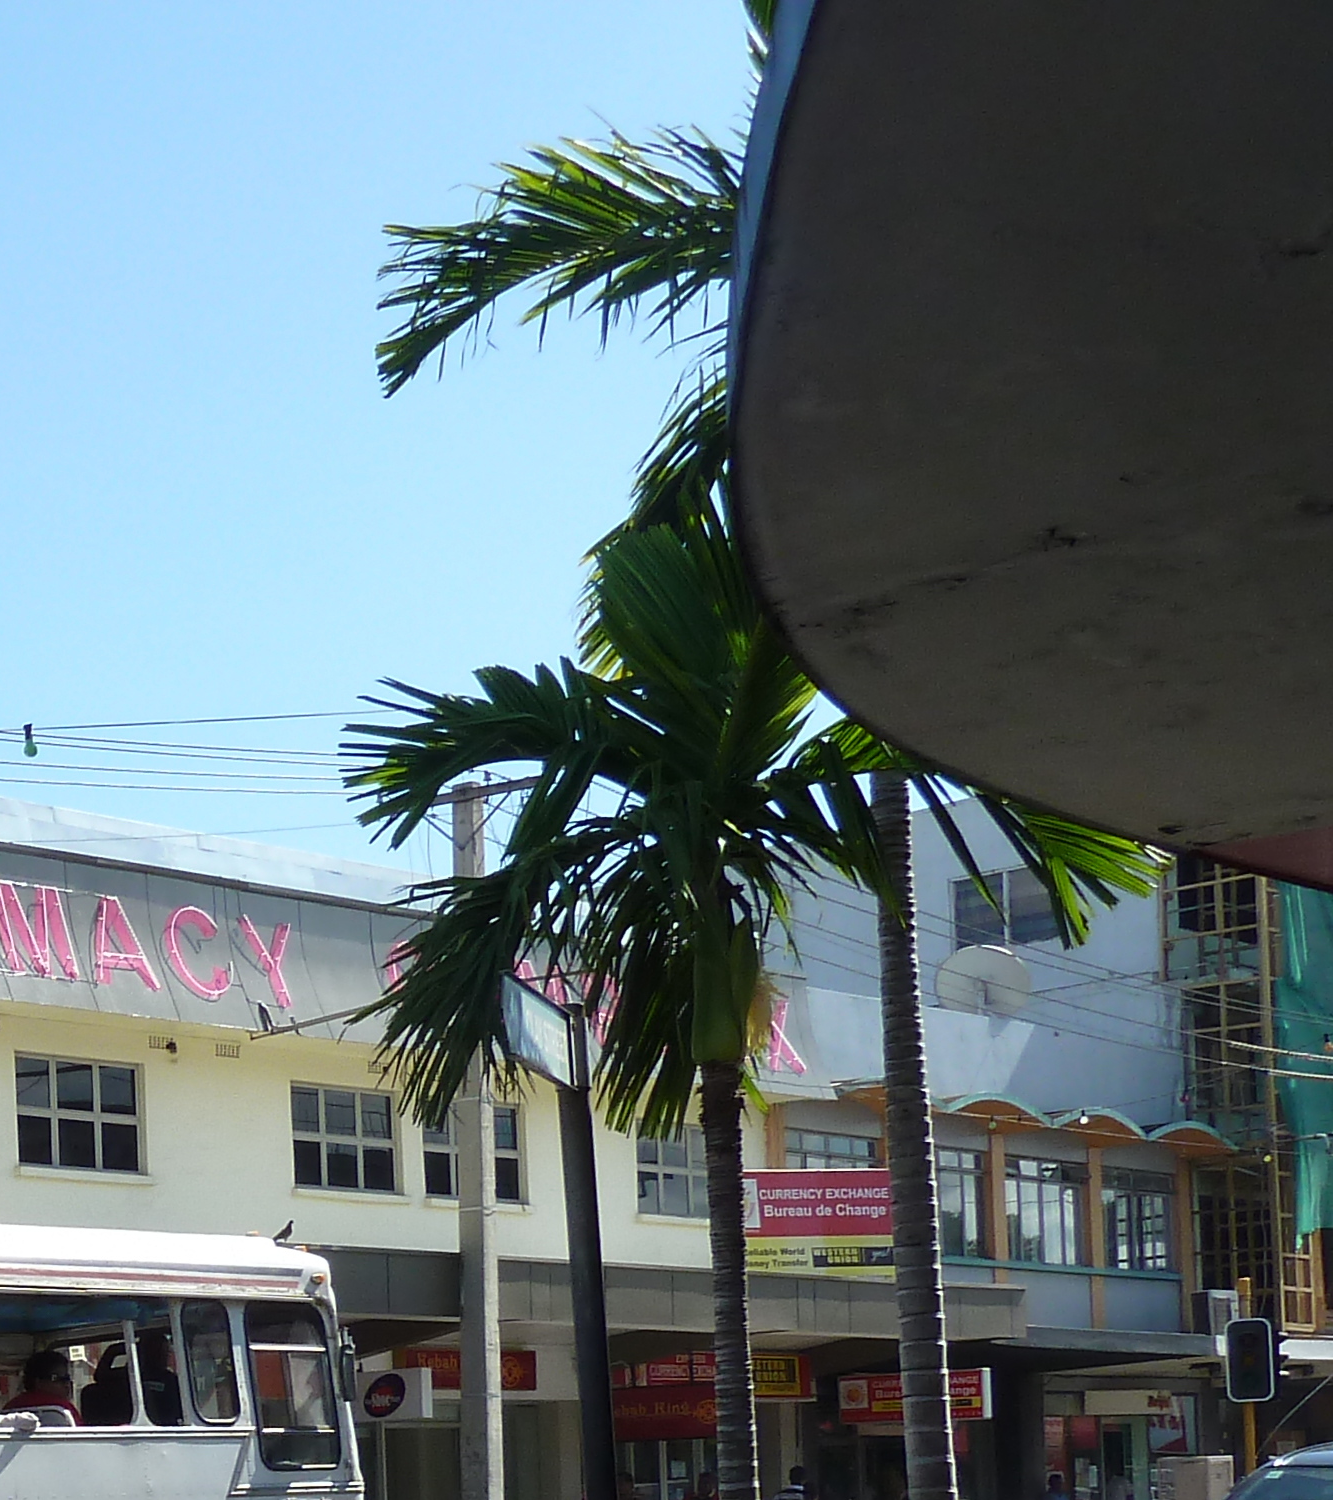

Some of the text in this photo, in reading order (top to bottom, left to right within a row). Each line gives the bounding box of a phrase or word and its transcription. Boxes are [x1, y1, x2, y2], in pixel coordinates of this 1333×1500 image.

[759, 1187, 890, 1200] CURRENCY EXCHANGE
[764, 1203, 886, 1218] Bureau de Change
